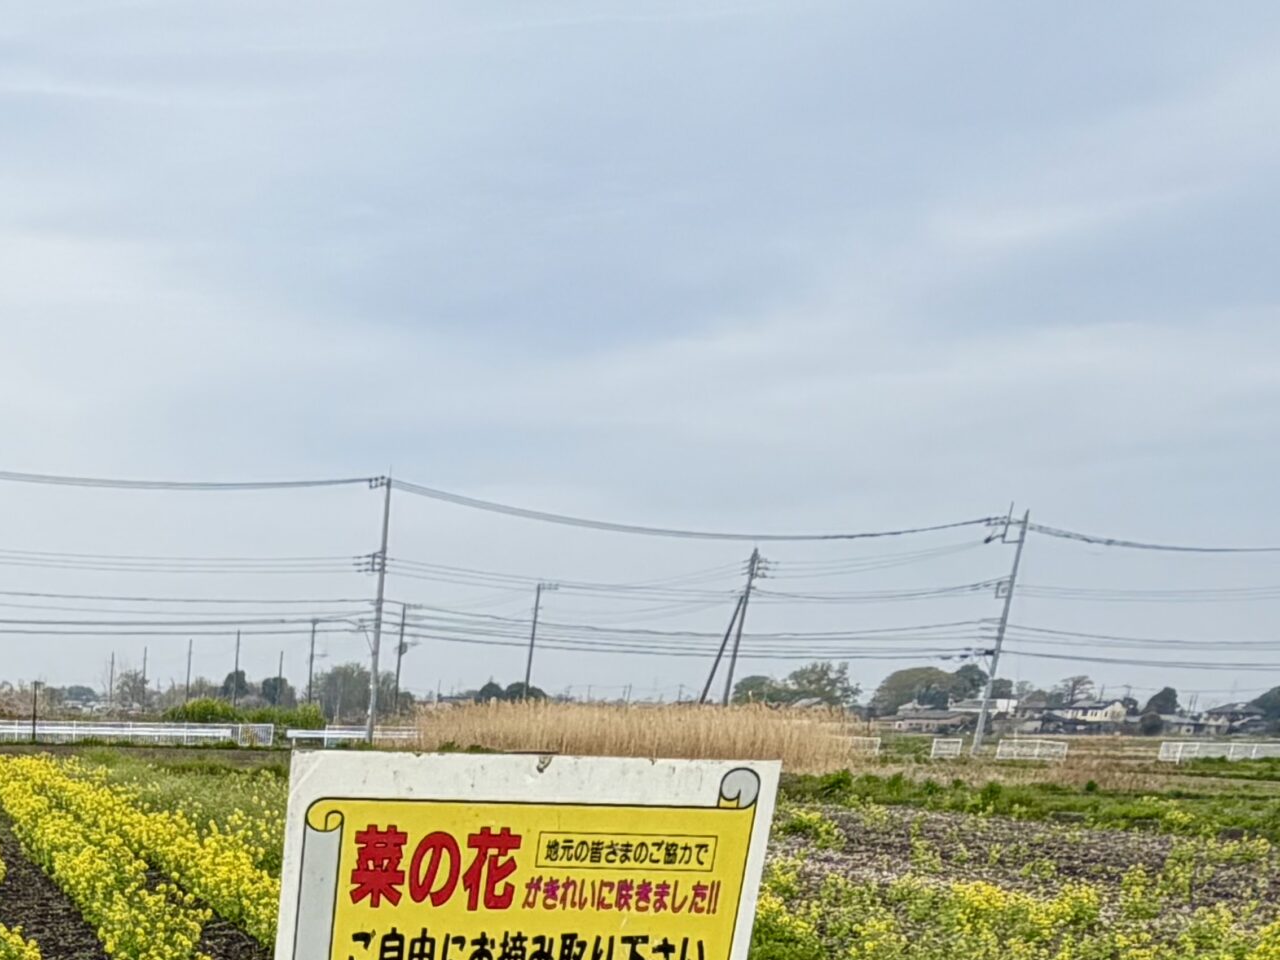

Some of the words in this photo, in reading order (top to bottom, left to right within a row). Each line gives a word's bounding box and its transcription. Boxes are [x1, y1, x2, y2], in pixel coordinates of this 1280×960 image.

[349, 824, 522, 911] 菜の花
[544, 839, 710, 866] 地元の皆さまのご協力で
